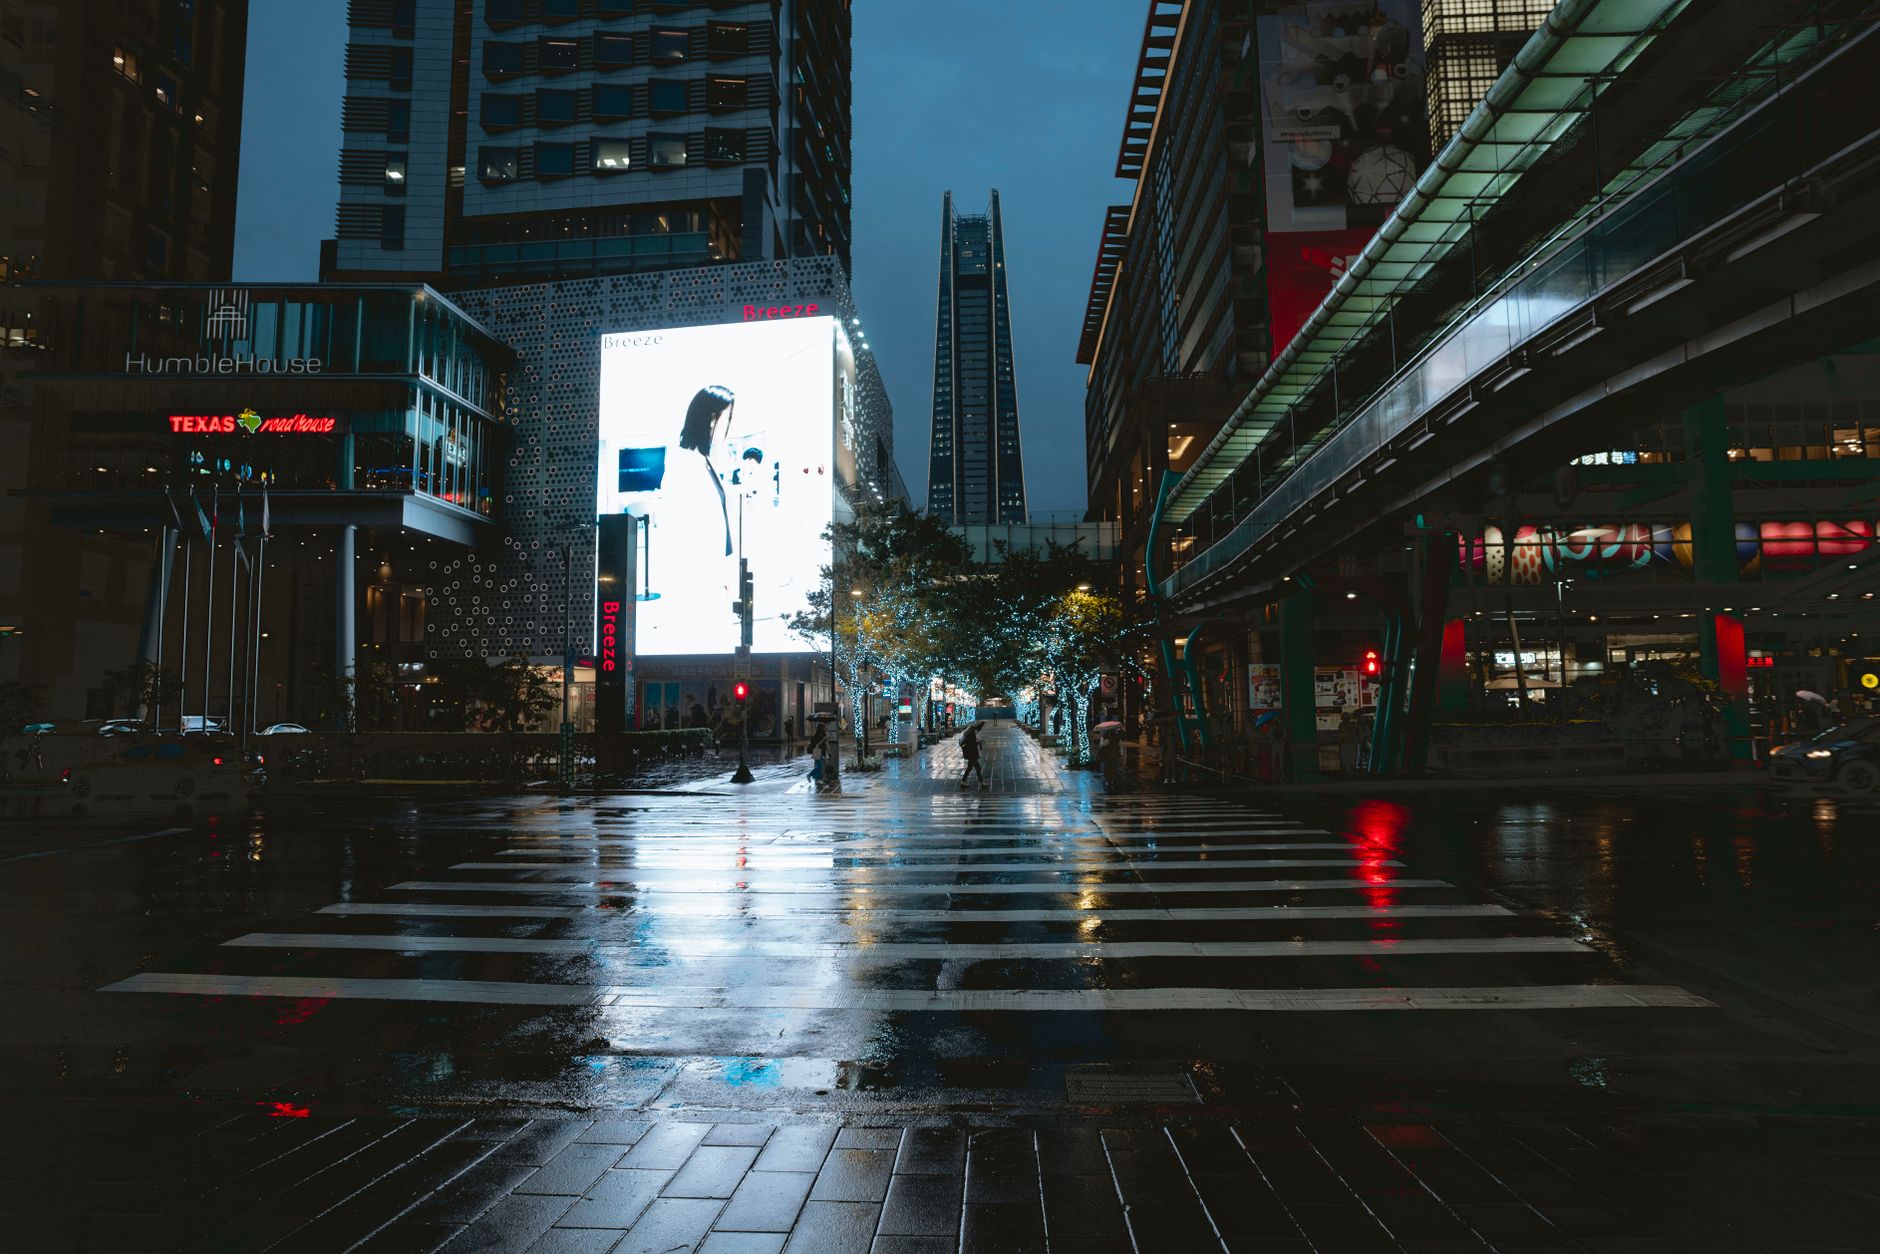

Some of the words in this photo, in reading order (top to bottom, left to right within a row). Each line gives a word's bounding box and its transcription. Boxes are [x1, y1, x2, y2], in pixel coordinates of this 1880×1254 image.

[743, 303, 819, 321] Breeze
[604, 335, 663, 349] Breeze
[125, 352, 322, 374] HumbleHouse
[169, 415, 236, 433] TEXAS
[260, 413, 335, 433] roadhouse
[602, 601, 620, 672] Breeze
